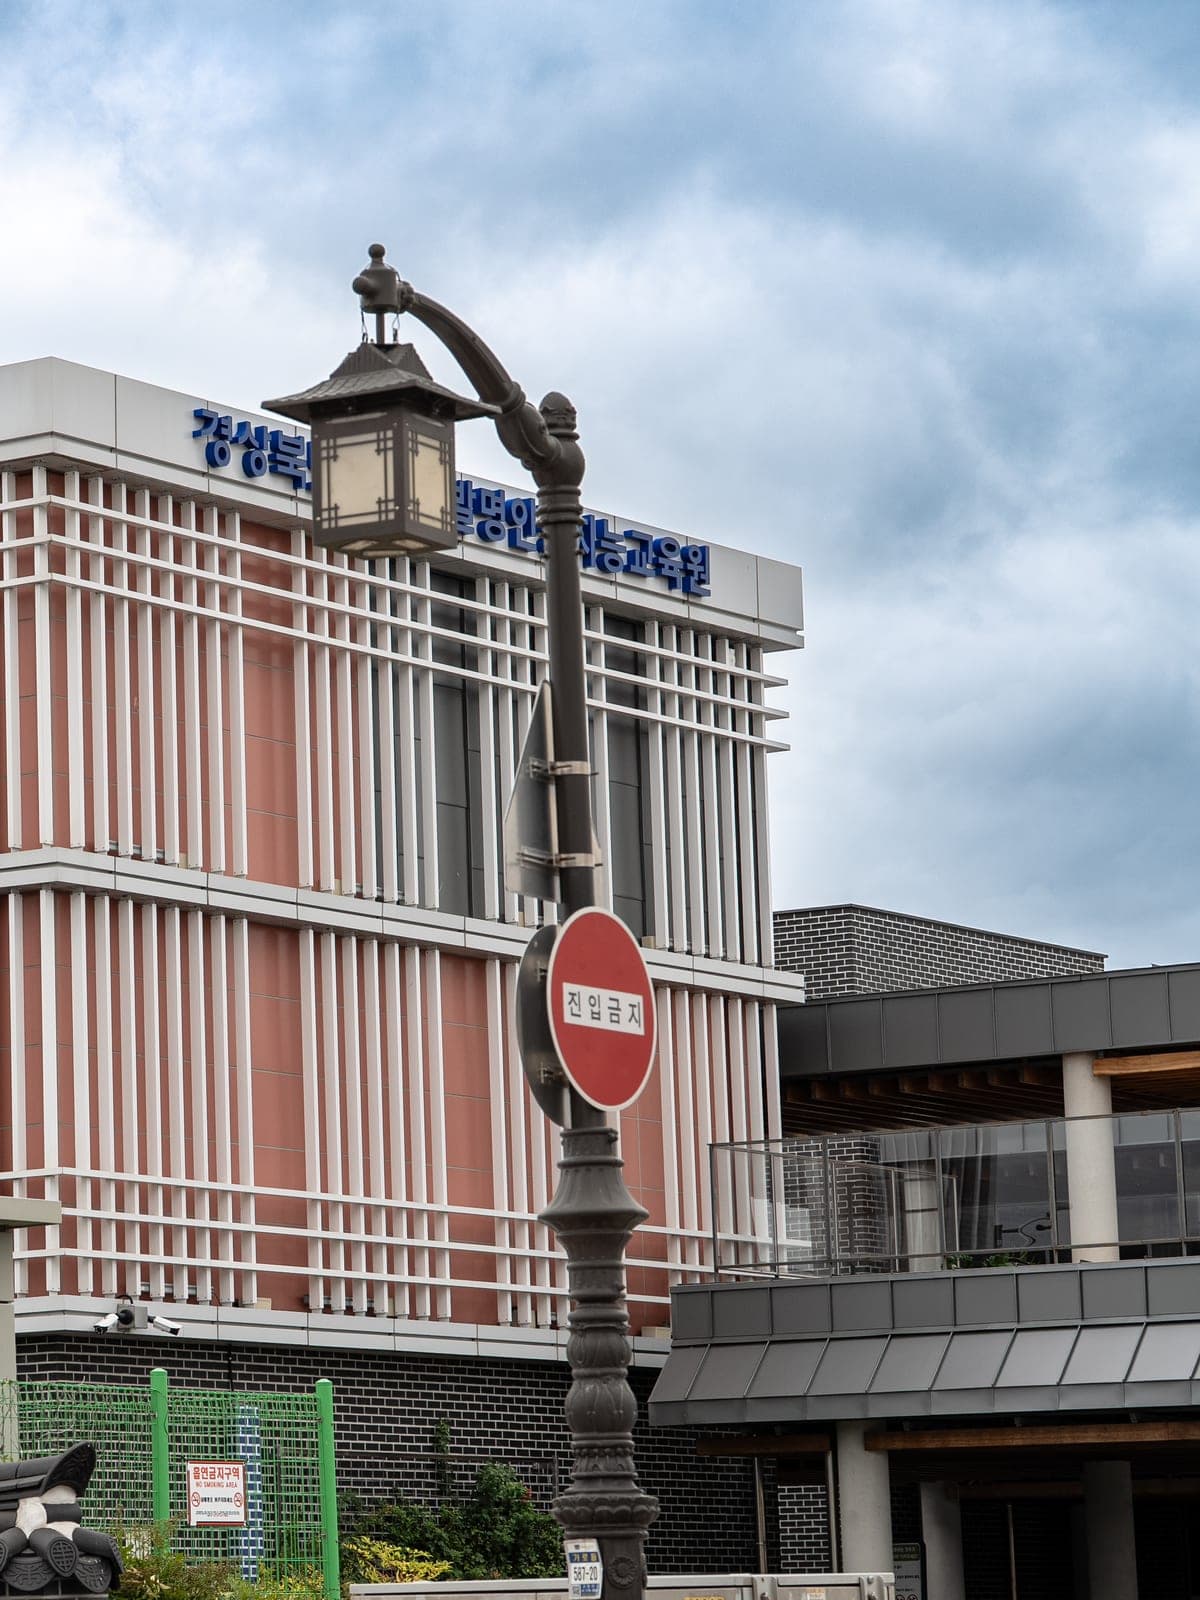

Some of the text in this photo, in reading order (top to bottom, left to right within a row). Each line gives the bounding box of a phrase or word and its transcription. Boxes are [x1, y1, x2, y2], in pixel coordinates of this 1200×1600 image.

[192, 408, 312, 491] 경상북
[568, 991, 641, 1028] 진입금지
[193, 1466, 240, 1480] 흡연금지구역
